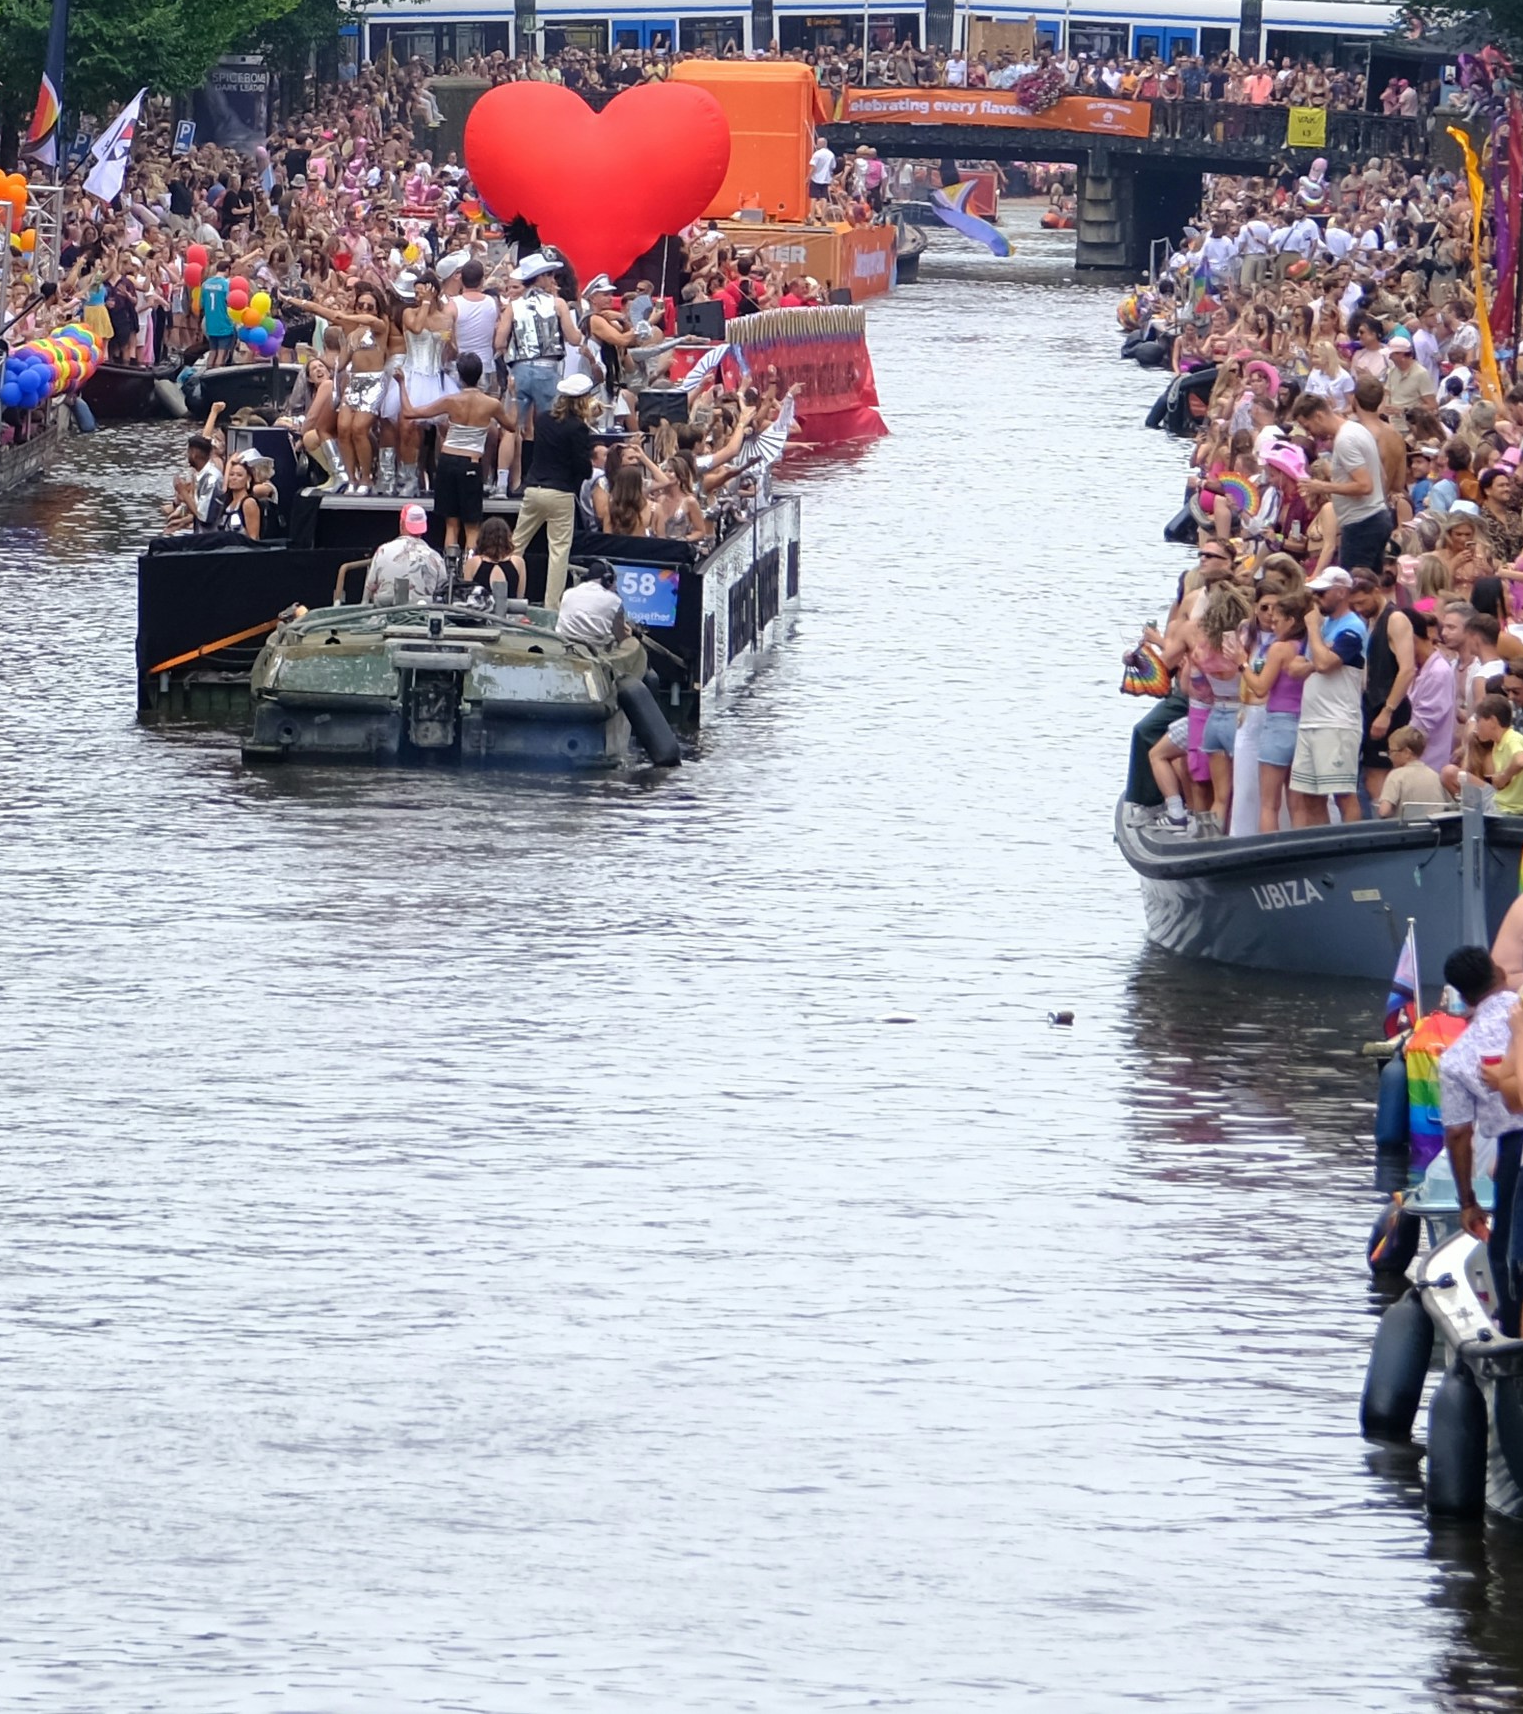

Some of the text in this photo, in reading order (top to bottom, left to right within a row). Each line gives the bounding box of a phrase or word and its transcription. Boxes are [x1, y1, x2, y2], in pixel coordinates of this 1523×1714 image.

[849, 98, 930, 114] elebrating
[933, 101, 976, 115] every
[180, 123, 191, 138] P
[621, 572, 656, 596] 58
[1251, 877, 1324, 911] IJBIZA
